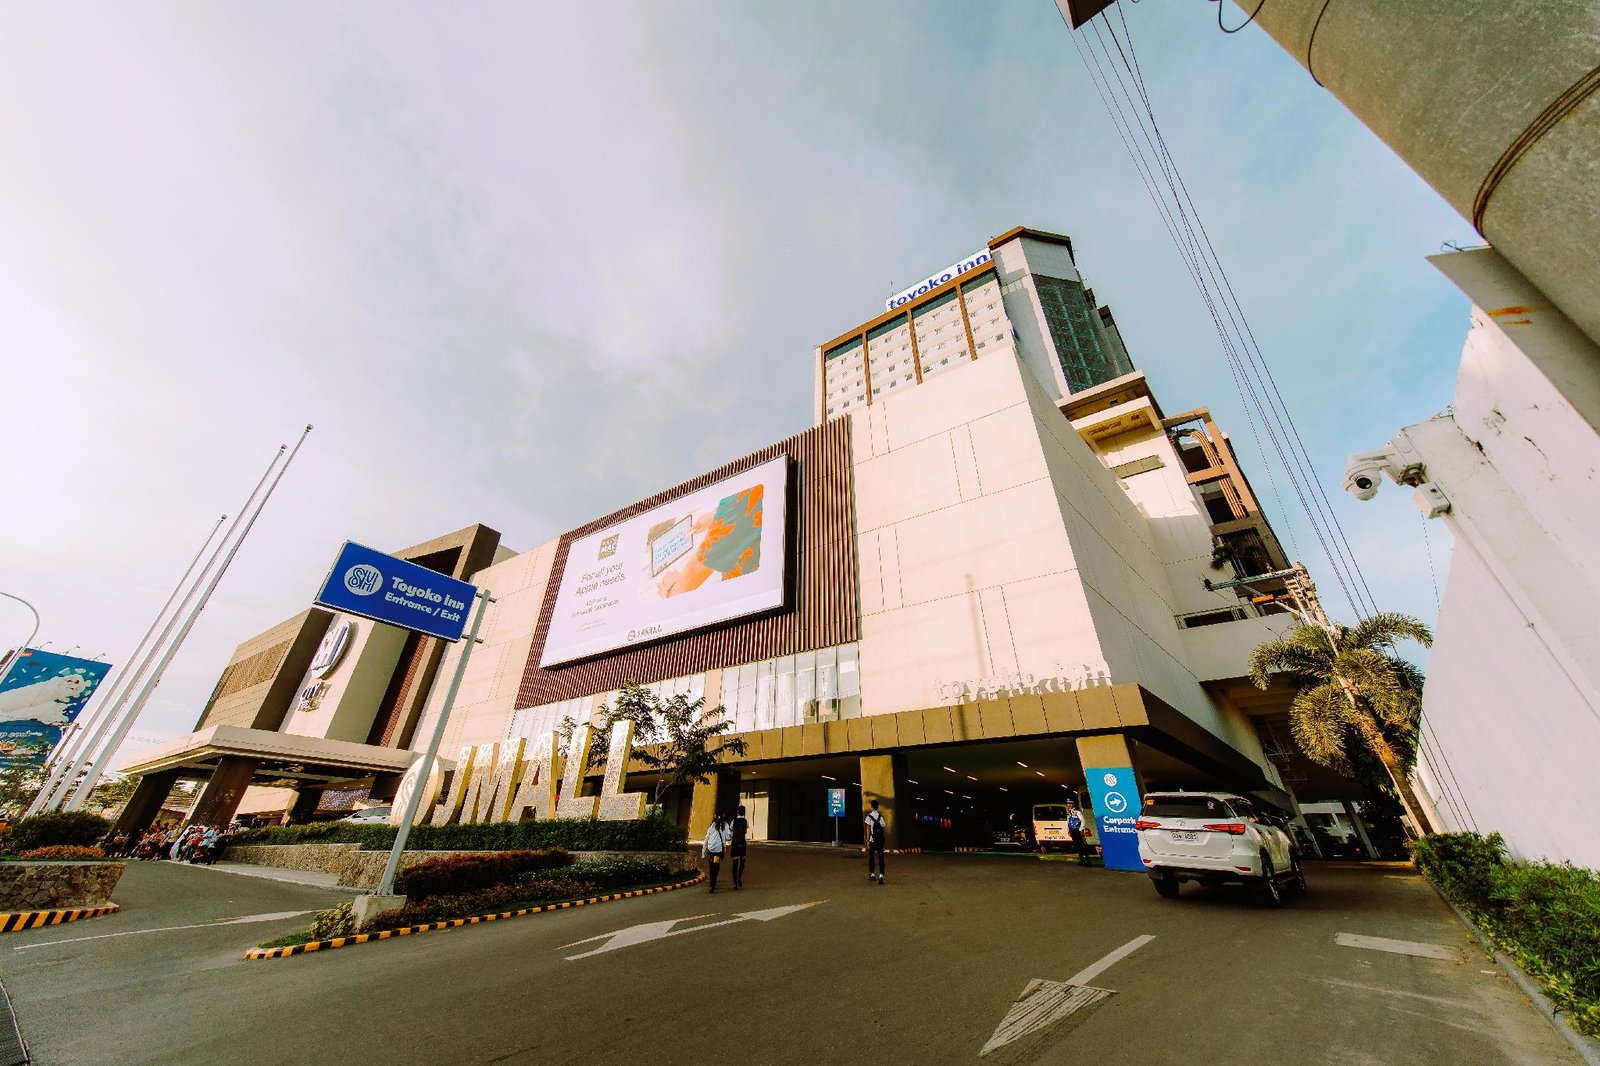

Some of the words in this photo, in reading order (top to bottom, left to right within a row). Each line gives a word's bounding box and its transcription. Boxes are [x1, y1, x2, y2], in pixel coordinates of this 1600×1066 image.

[957, 254, 988, 274] inn
[605, 562, 624, 578] your
[599, 573, 626, 589] needs
[392, 576, 442, 604] Toyoko
[443, 594, 465, 611] Inn
[384, 591, 433, 614] Entrance
[440, 609, 462, 622] Exit
[1103, 815, 1136, 825] Carpark
[1103, 825, 1136, 834] Entranc
